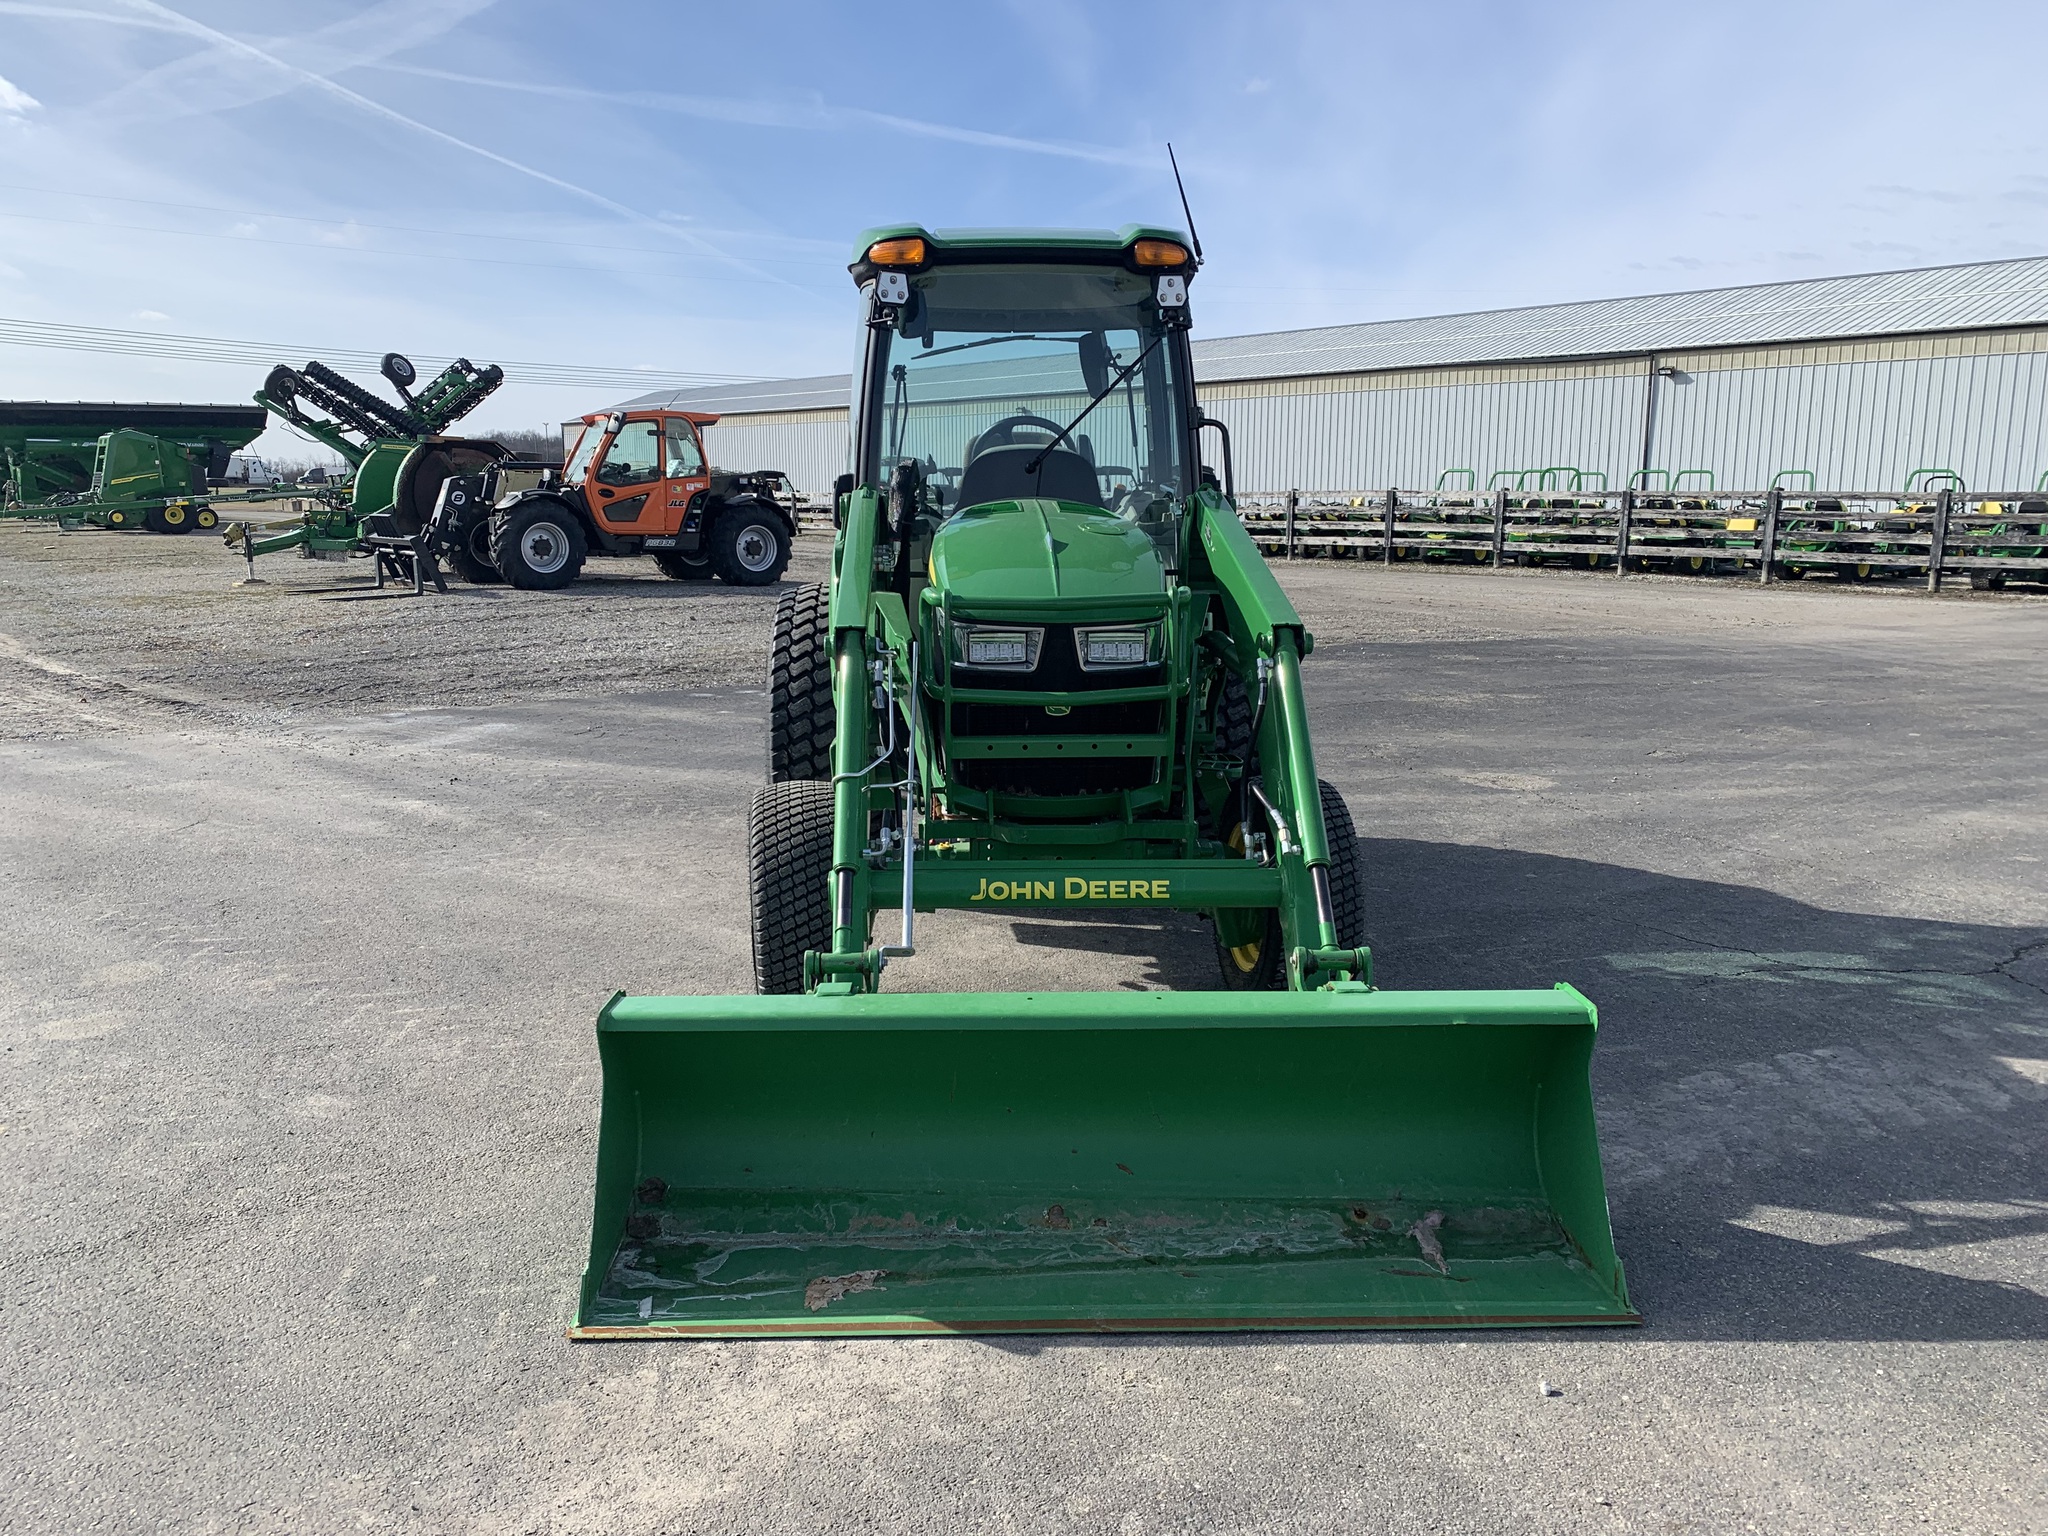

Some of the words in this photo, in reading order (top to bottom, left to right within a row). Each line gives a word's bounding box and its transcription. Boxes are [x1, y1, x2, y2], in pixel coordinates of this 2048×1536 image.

[668, 500, 686, 508] JLG
[970, 878, 1054, 901] JOHN
[1064, 877, 1170, 899] DEERE
